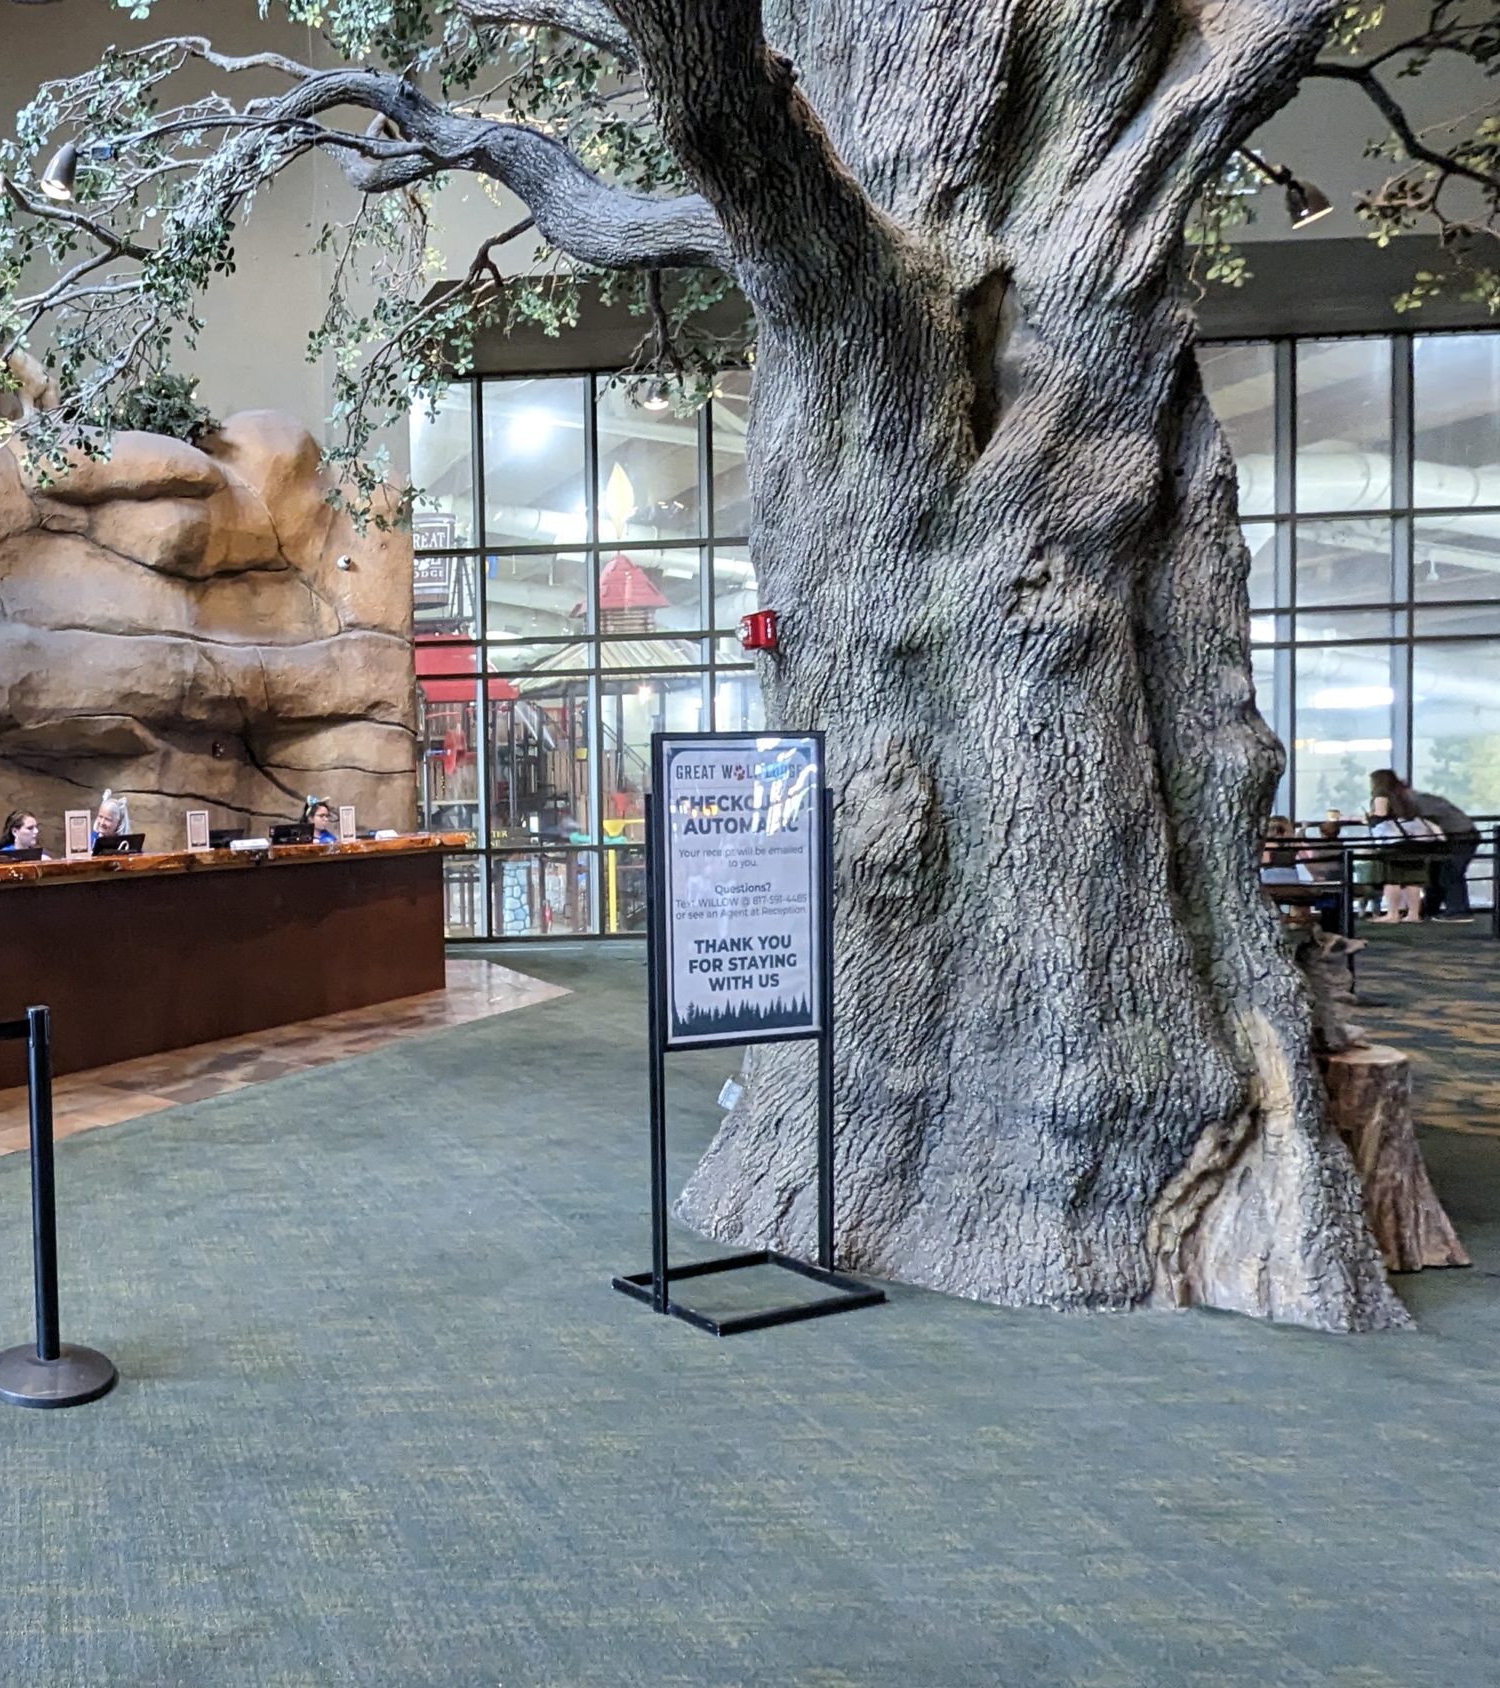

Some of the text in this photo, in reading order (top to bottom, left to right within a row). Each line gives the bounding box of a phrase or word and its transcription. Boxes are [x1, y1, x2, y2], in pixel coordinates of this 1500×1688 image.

[413, 532, 446, 548] REAT
[676, 764, 716, 780] GREAT
[721, 764, 757, 781] WL
[676, 794, 779, 812] CHECKOU
[683, 817, 799, 835] AUTOMAIC
[678, 849, 700, 858] Your
[702, 849, 735, 859] recept
[755, 846, 766, 855] be
[714, 882, 772, 896] Questions?
[698, 897, 739, 907] WILLOW
[675, 911, 686, 920] or
[688, 910, 704, 919] see
[693, 934, 792, 955] THANK YOU
[688, 953, 797, 974] FOR STAYING
[708, 973, 780, 992] WITH US
